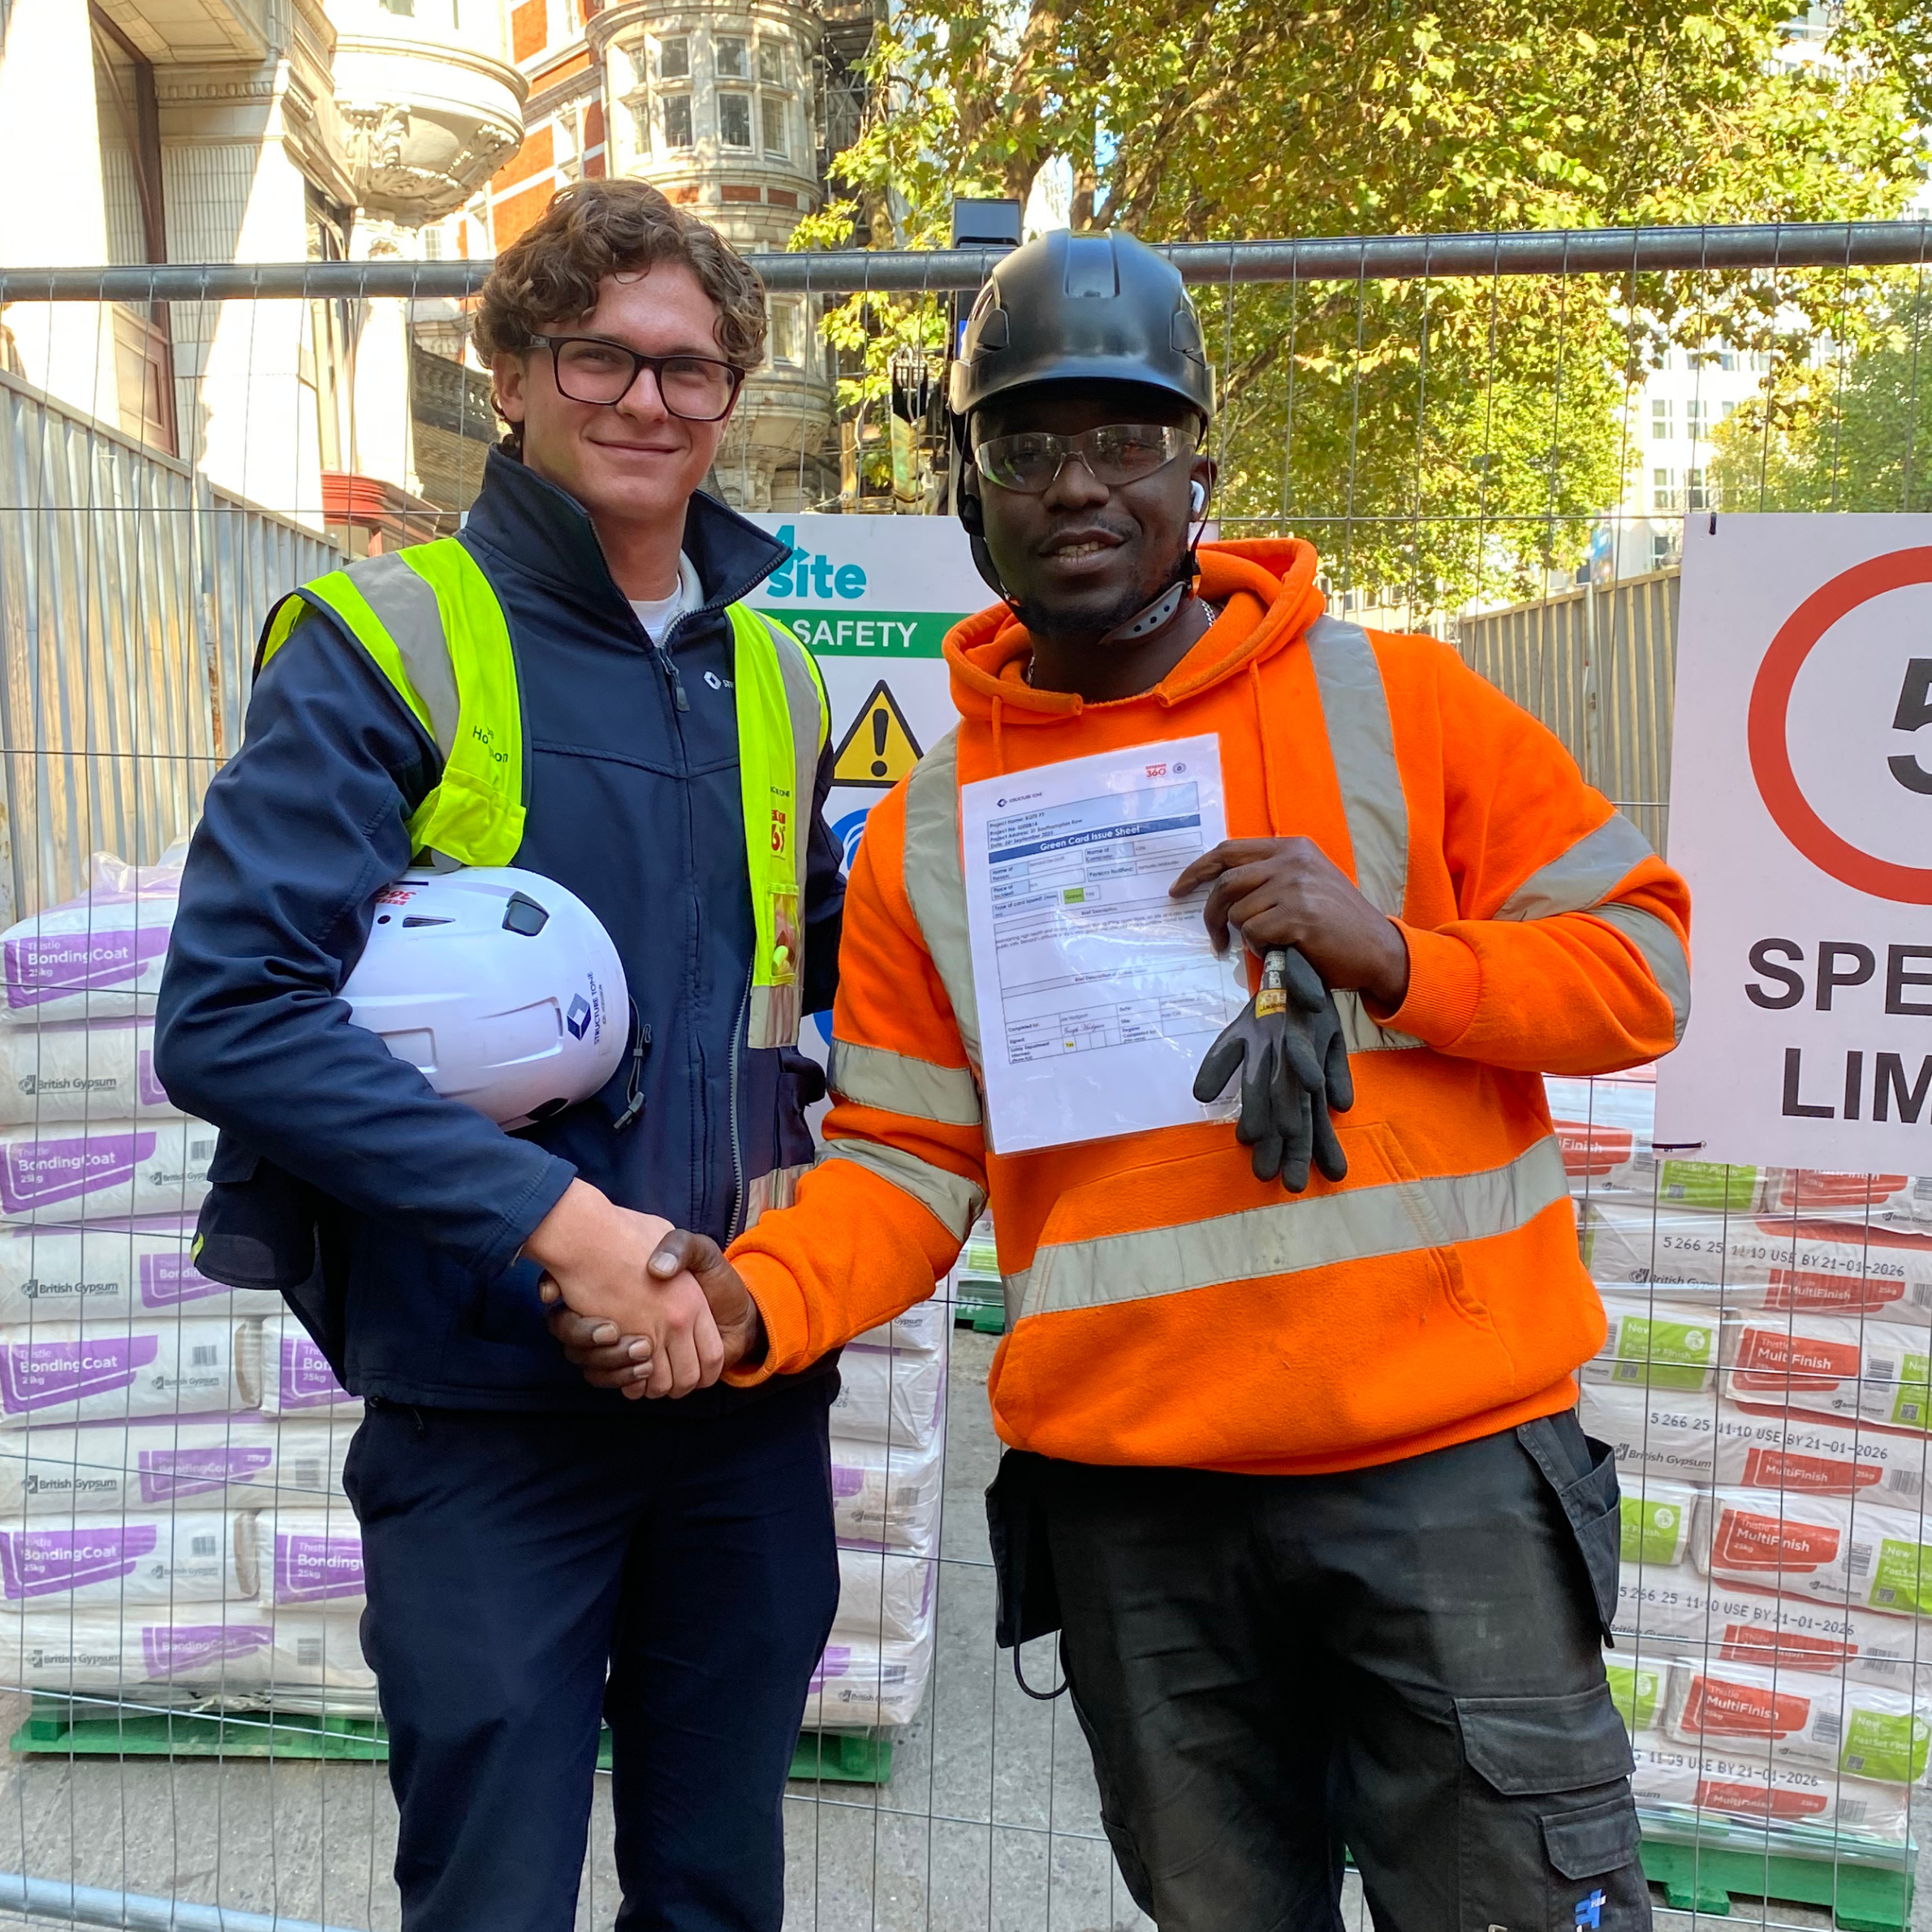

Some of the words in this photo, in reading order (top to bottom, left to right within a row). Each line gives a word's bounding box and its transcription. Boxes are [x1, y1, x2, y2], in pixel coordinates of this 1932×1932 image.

[766, 555, 867, 600] site
[792, 619, 918, 648] SAFETY
[1145, 767, 1167, 778] 360
[989, 821, 1007, 829] Project
[990, 834, 1007, 843] Project
[1037, 821, 1070, 833] Southampton
[990, 828, 1007, 836] Project
[1013, 834, 1041, 844] September
[1039, 839, 1066, 851] Green
[1067, 834, 1089, 845] Card
[1090, 830, 1113, 840] Issue
[1115, 826, 1140, 837] Sheet
[1064, 892, 1082, 900] Green
[28, 947, 129, 966] BondingCoat
[587, 971, 597, 997] TONE
[593, 997, 601, 1046] STRUCTURE
[37, 1078, 71, 1090] British
[73, 1078, 116, 1091] Gypsum
[1804, 1178, 1825, 1188] 25kg
[1663, 1236, 1672, 1248] 5
[1675, 1237, 1701, 1252] 266
[1706, 1240, 1725, 1254] 25
[1771, 1249, 1797, 1264] USE
[1801, 1254, 1820, 1267] BY
[1821, 1257, 1905, 1277] 21-01-2026
[1650, 1273, 1684, 1286] British
[39, 1283, 72, 1294] British
[75, 1282, 118, 1295] Gypsum
[1788, 1284, 1851, 1301] MultiFinish
[1878, 1286, 1898, 1296] 25kg
[894, 1317, 923, 1327] Gypsum
[20, 1356, 118, 1374] BondingCoat
[1757, 1348, 1831, 1370] MultFinish
[303, 1373, 326, 1383] 25kg
[1650, 1412, 1660, 1425] 5
[1661, 1414, 1688, 1428] 266
[1693, 1418, 1710, 1431] 25
[1718, 1421, 1753, 1438] 11:10
[1757, 1428, 1782, 1443] USE
[1787, 1433, 1804, 1446] BY
[1805, 1437, 1889, 1460] 21-01-2026
[1628, 1448, 1664, 1463] British
[1666, 1455, 1712, 1468] Gypsum
[1766, 1464, 1828, 1483] MultiFinish
[1856, 1471, 1875, 1481] 25kg
[39, 1478, 72, 1490] British
[75, 1478, 118, 1491] Gypsum
[1741, 1517, 1770, 1533] Thistle
[1737, 1528, 1810, 1552] MultiFnish
[22, 1545, 118, 1562] BondingCoat
[1733, 1543, 1754, 1554] 25kg
[1887, 1546, 1911, 1559] New
[298, 1554, 364, 1572] Bonding
[297, 1569, 321, 1580] 25kg
[1619, 1586, 1628, 1598] 5
[1629, 1588, 1656, 1601] 266
[1661, 1592, 1679, 1604] 25
[1686, 1596, 1719, 1611] 11:0
[1723, 1602, 1749, 1617] USE
[1754, 1607, 1773, 1621] BY
[1773, 1611, 1856, 1637] 21-01-2026
[851, 1693, 873, 1702] British
[1710, 1685, 1740, 1699] Thistle
[1706, 1695, 1779, 1721] MultiFinish
[1857, 1715, 1881, 1729] New
[1718, 1762, 1736, 1775] BY
[1738, 1765, 1819, 1787] 21-01-2026
